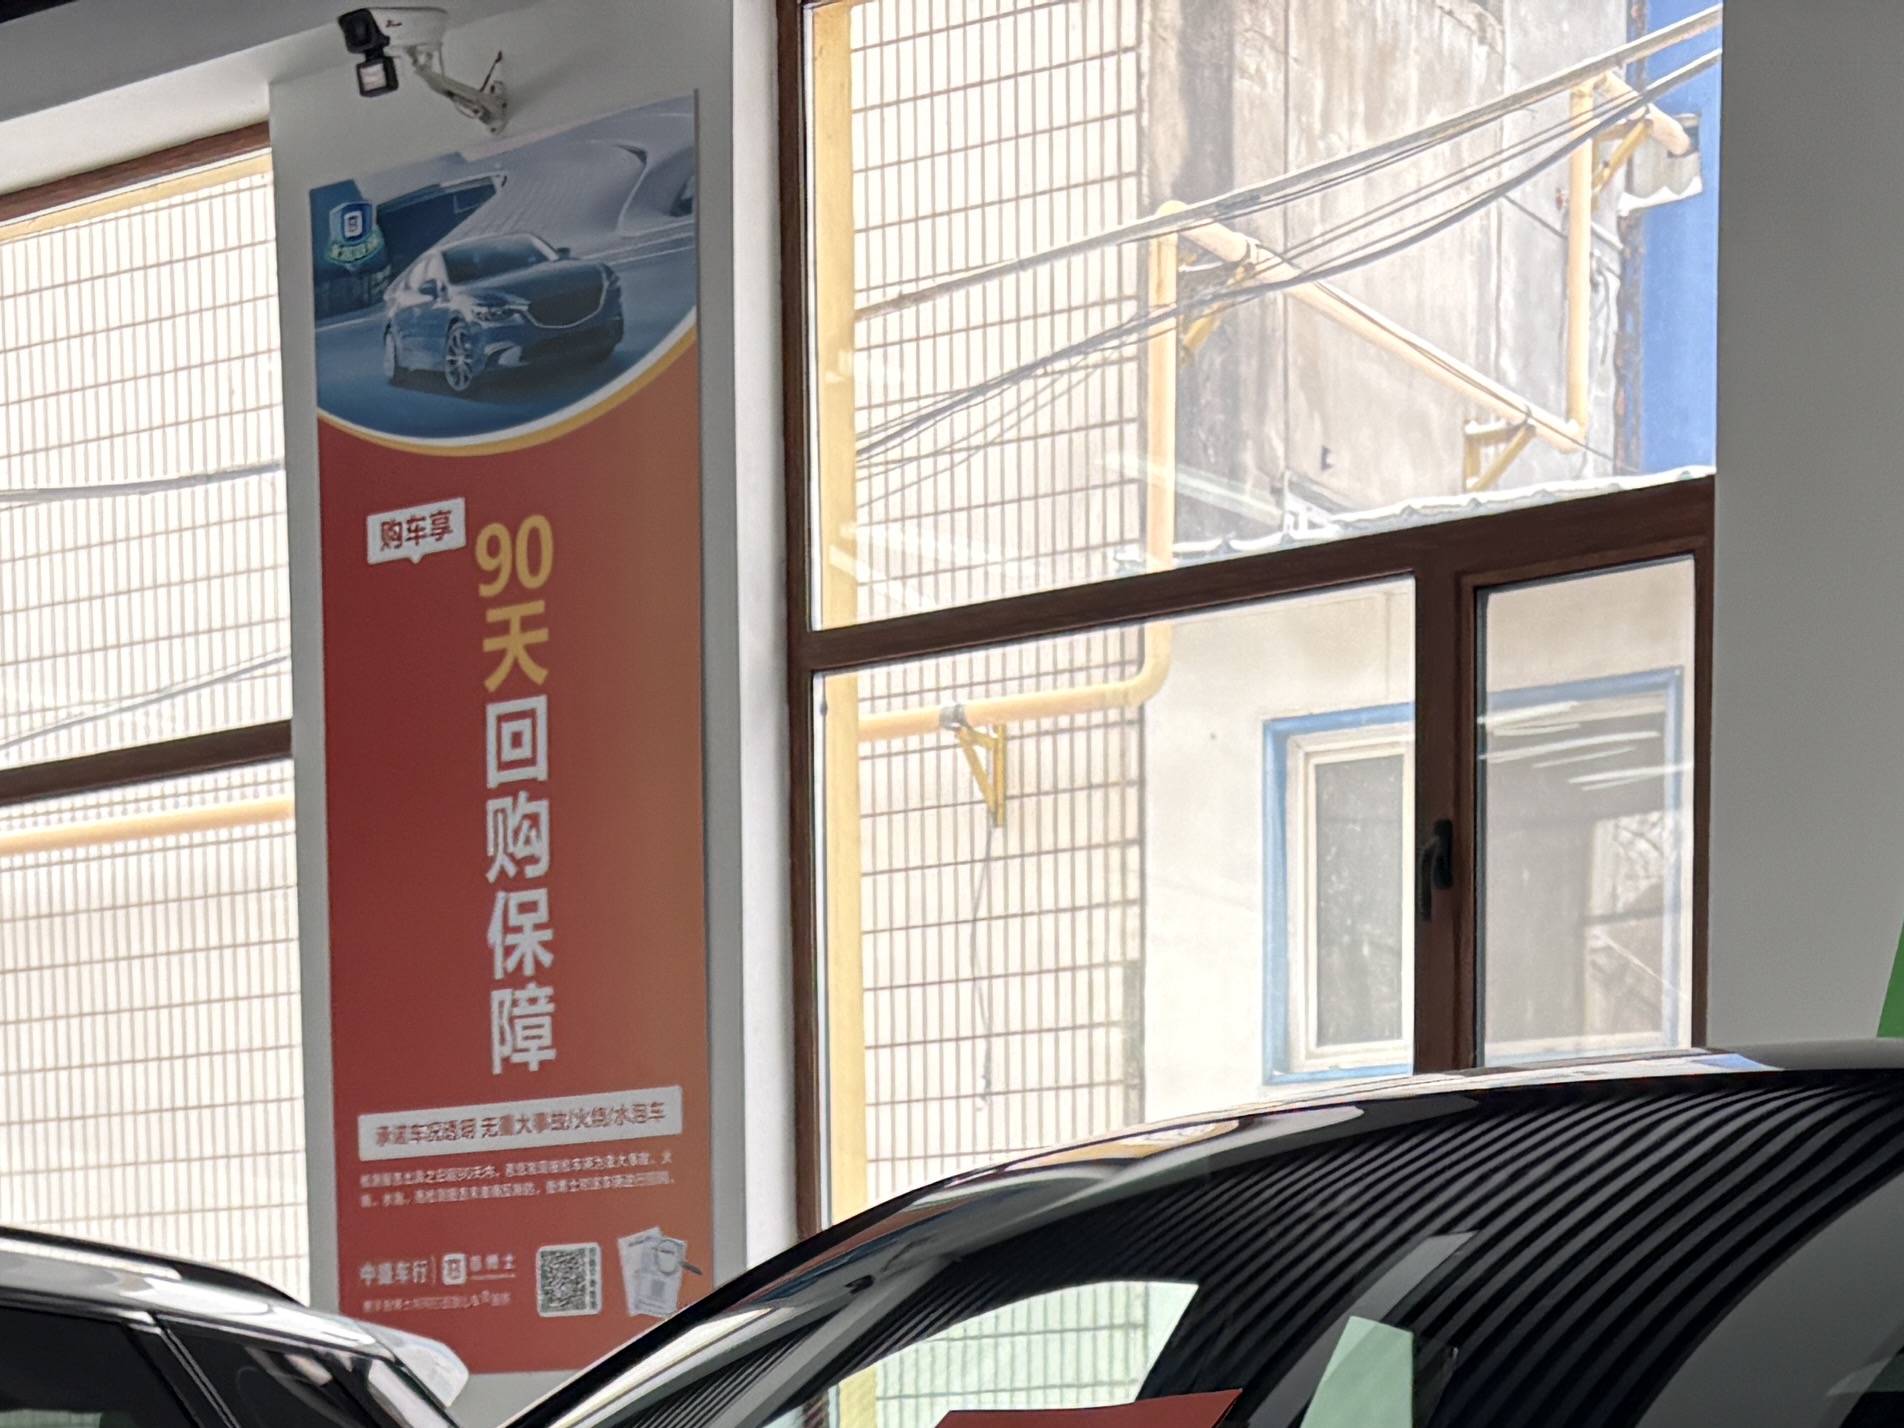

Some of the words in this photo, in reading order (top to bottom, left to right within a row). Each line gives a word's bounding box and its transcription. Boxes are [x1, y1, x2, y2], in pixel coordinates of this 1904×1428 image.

[380, 510, 452, 551] 购车享
[474, 515, 556, 1075] 90天回购保障
